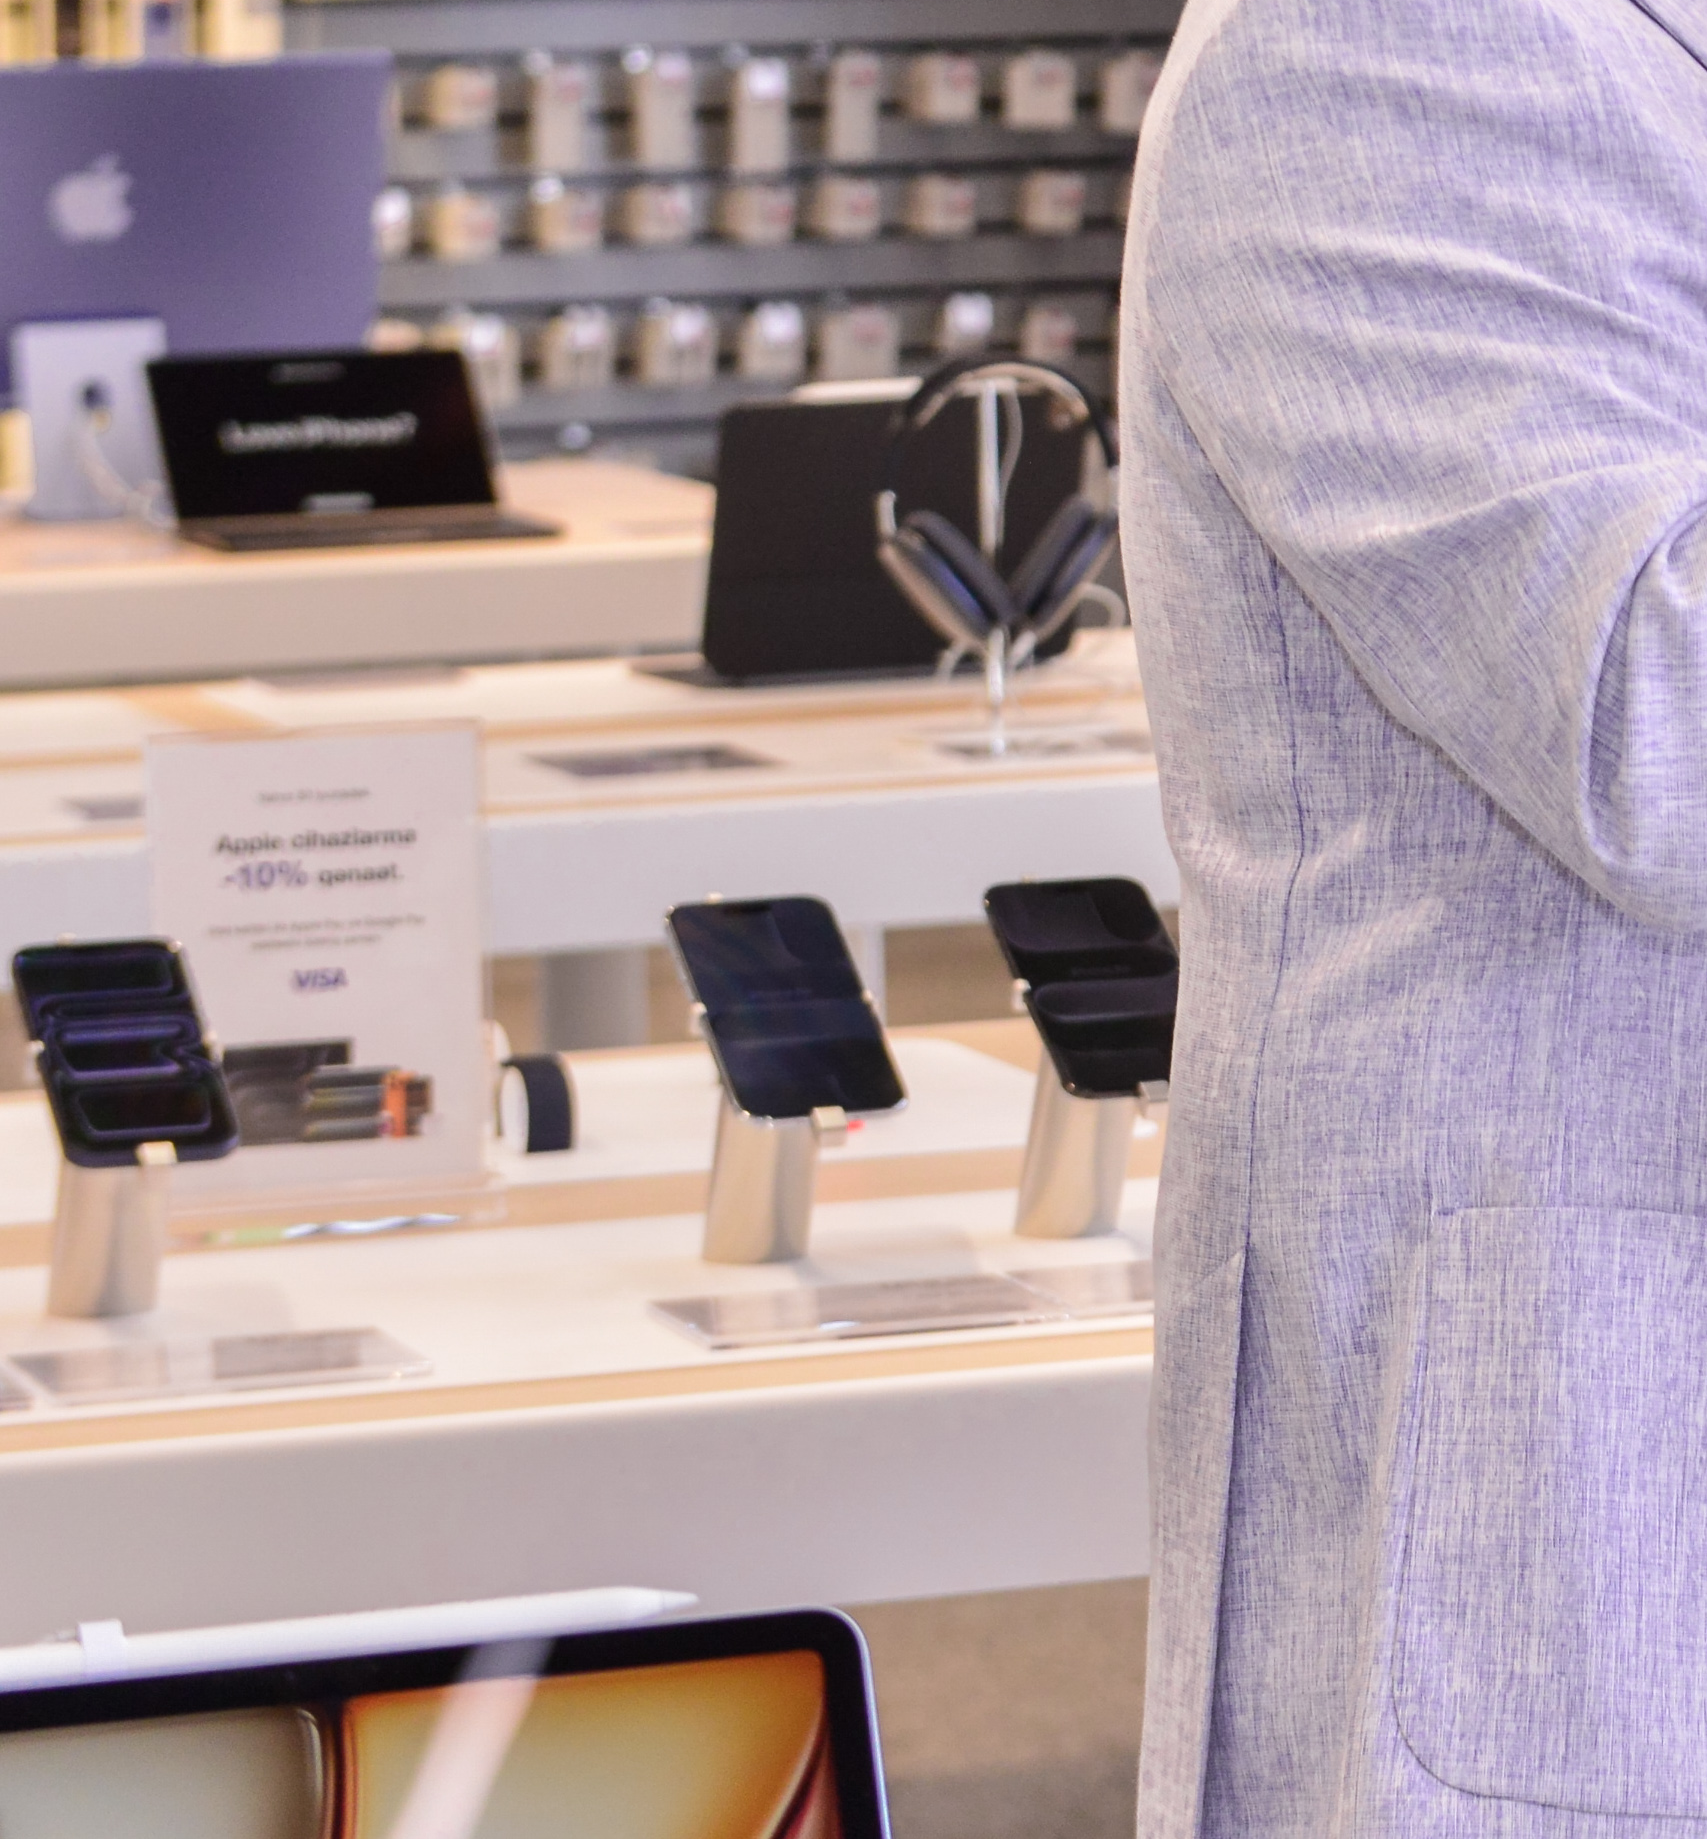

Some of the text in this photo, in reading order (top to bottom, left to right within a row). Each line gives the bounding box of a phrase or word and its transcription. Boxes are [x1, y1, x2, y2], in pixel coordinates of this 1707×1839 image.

[215, 832, 284, 857] Apple
[222, 859, 309, 890] -10%
[292, 967, 348, 992] VISA
